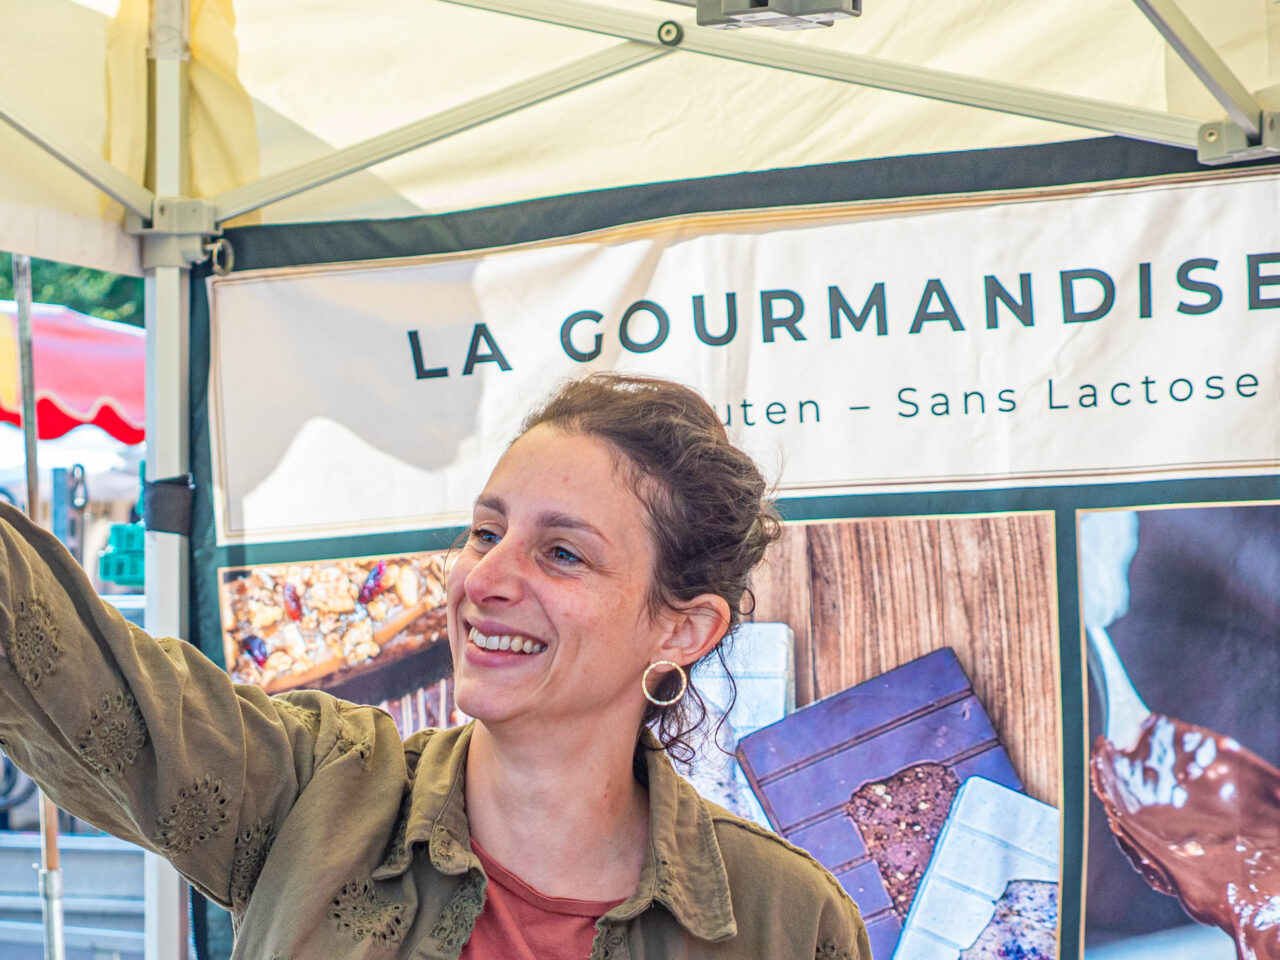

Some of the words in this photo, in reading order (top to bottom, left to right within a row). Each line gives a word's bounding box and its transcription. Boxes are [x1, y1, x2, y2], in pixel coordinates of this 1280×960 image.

[407, 323, 512, 379] LA
[560, 252, 1280, 362] GOURMANDISE
[713, 399, 819, 426] uten
[897, 387, 1016, 417] Sans
[1048, 373, 1259, 409] Lactose
